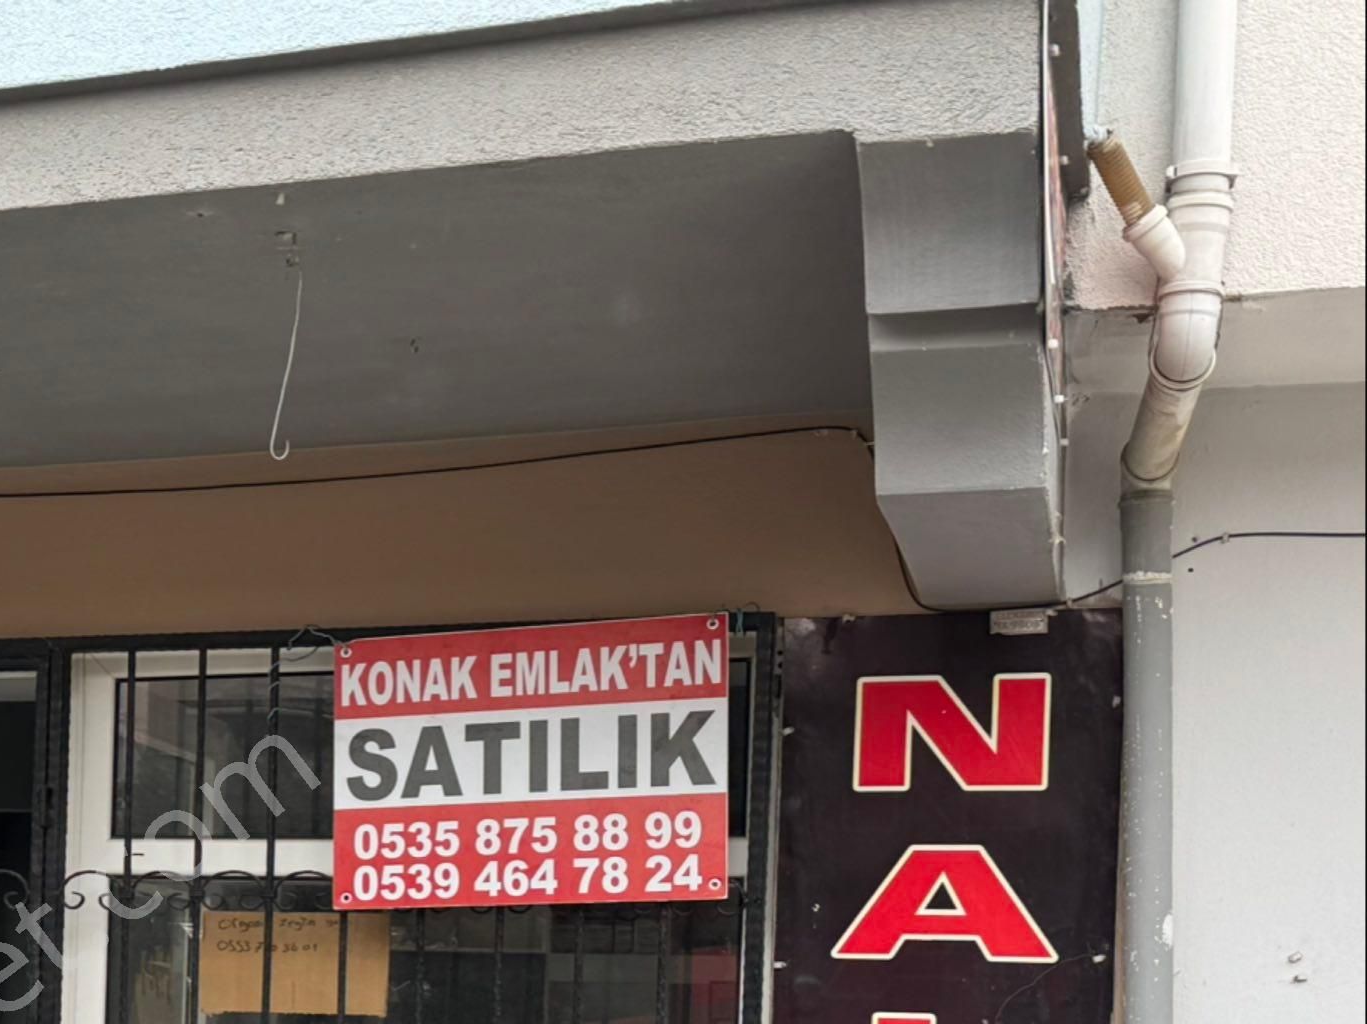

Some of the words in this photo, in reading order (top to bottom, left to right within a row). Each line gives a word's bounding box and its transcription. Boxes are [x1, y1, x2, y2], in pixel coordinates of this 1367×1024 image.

[341, 656, 477, 707] KONAK
[490, 639, 722, 698] EMLAK'TAN
[346, 710, 716, 802] SATILIK
[354, 821, 459, 860] 0535
[475, 817, 557, 856] 875
[574, 813, 628, 852] 88
[645, 810, 702, 850] 99
[353, 863, 459, 901] 0539
[474, 858, 557, 897] 464
[574, 856, 628, 894] 78
[645, 854, 702, 892] 24
